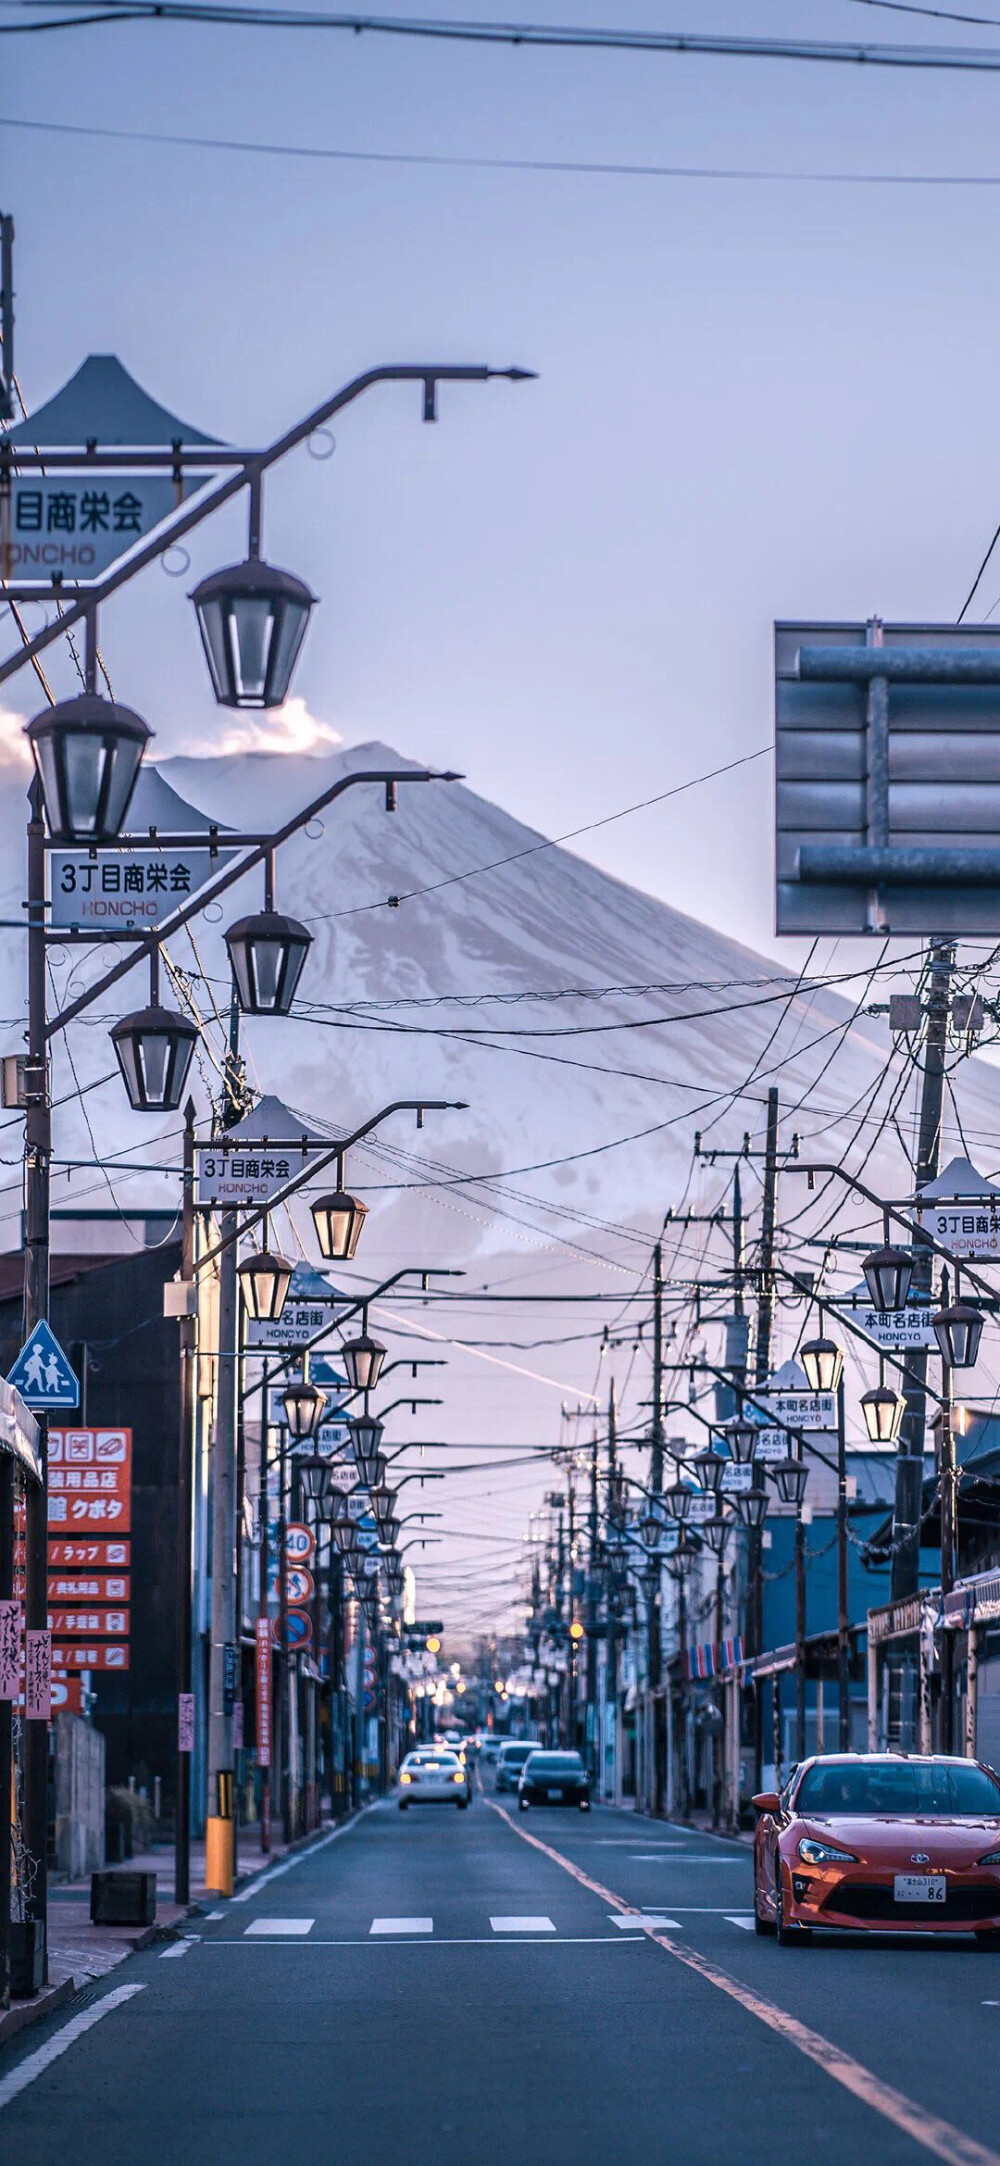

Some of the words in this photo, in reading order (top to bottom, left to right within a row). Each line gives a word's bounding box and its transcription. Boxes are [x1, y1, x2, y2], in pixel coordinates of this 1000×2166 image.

[16, 491, 143, 533] 目商栄会
[61, 863, 191, 893] 3丁目商栄会
[82, 901, 158, 916] HONCHO
[204, 1158, 290, 1179] 3丁目商栄会
[218, 1183, 269, 1193] HONCHO
[951, 1239, 998, 1249] HONCHO
[266, 1329, 310, 1339] HONCYO
[878, 1332, 922, 1341] HONCYO
[775, 1399, 833, 1412] 本町名店街
[786, 1415, 822, 1423] HONCYO
[286, 1534, 308, 1551] 40
[927, 1887, 943, 1900] 86
